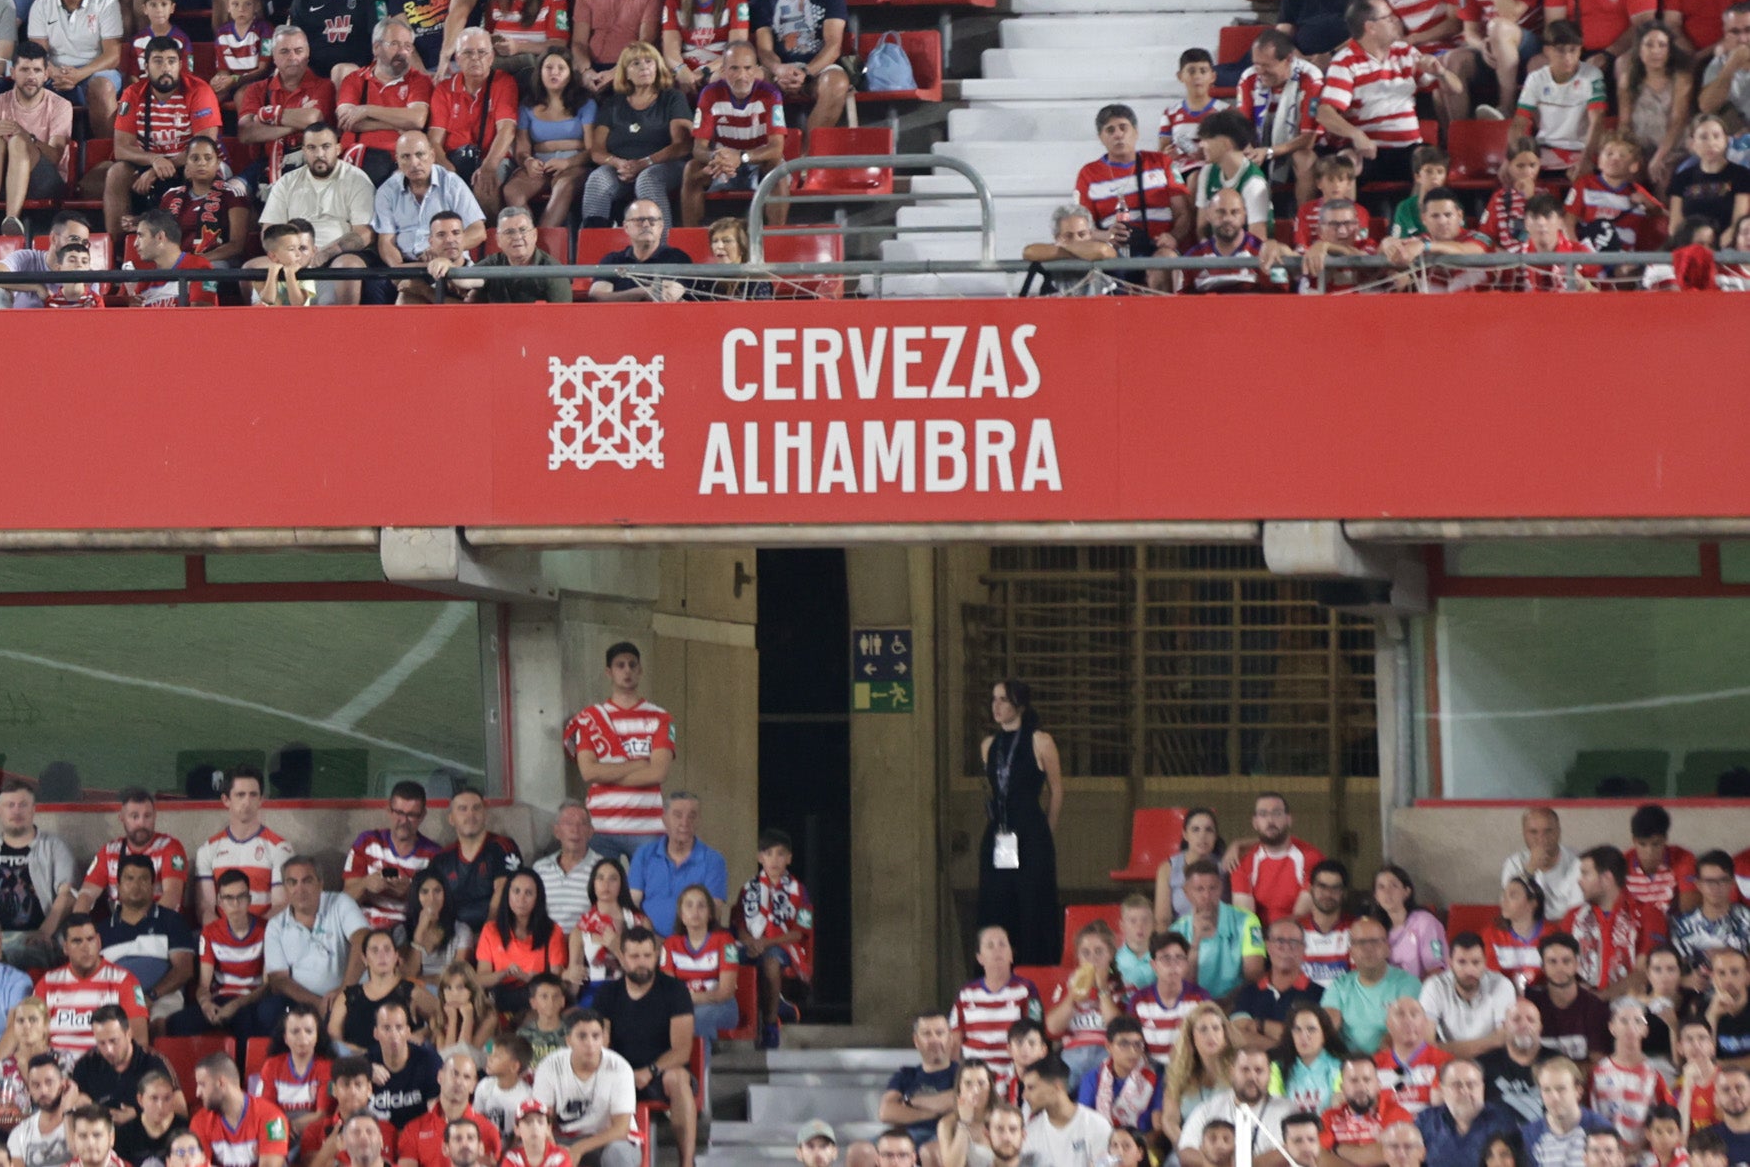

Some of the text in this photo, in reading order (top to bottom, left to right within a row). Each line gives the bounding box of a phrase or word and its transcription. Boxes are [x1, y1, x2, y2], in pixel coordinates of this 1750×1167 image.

[723, 324, 1040, 401] CERVEZAS
[699, 419, 1062, 494] ALHAMBRA
[623, 736, 652, 755] atzi
[57, 1009, 92, 1026] Plat
